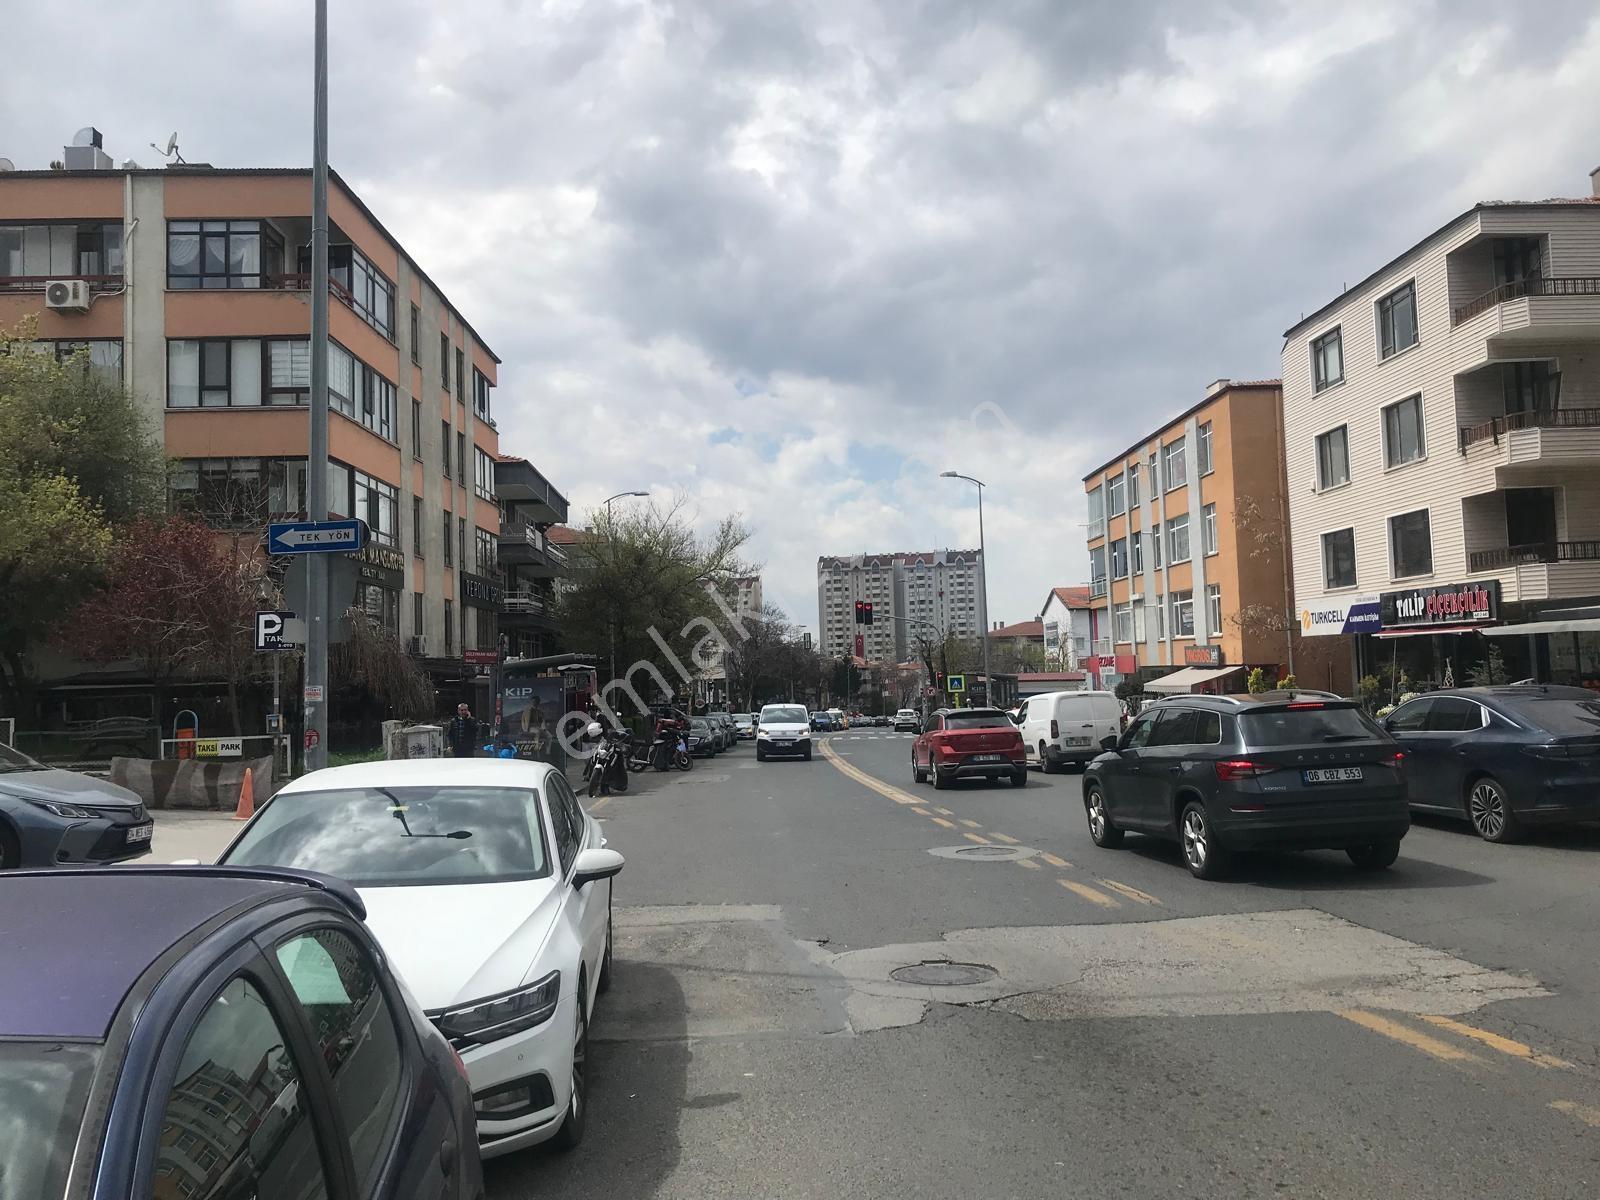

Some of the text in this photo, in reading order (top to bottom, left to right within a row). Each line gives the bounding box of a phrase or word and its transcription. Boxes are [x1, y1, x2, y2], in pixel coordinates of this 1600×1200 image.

[300, 530, 350, 541] TEK YÖN
[1396, 584, 1489, 620] TALİP ÇİÇEKÇİLİK
[1310, 609, 1345, 625] TURKCELL
[258, 613, 282, 647] P
[220, 743, 241, 751] PARK
[1308, 770, 1320, 781] 06
[1323, 769, 1341, 780] CBZ
[1343, 768, 1361, 779] 553
